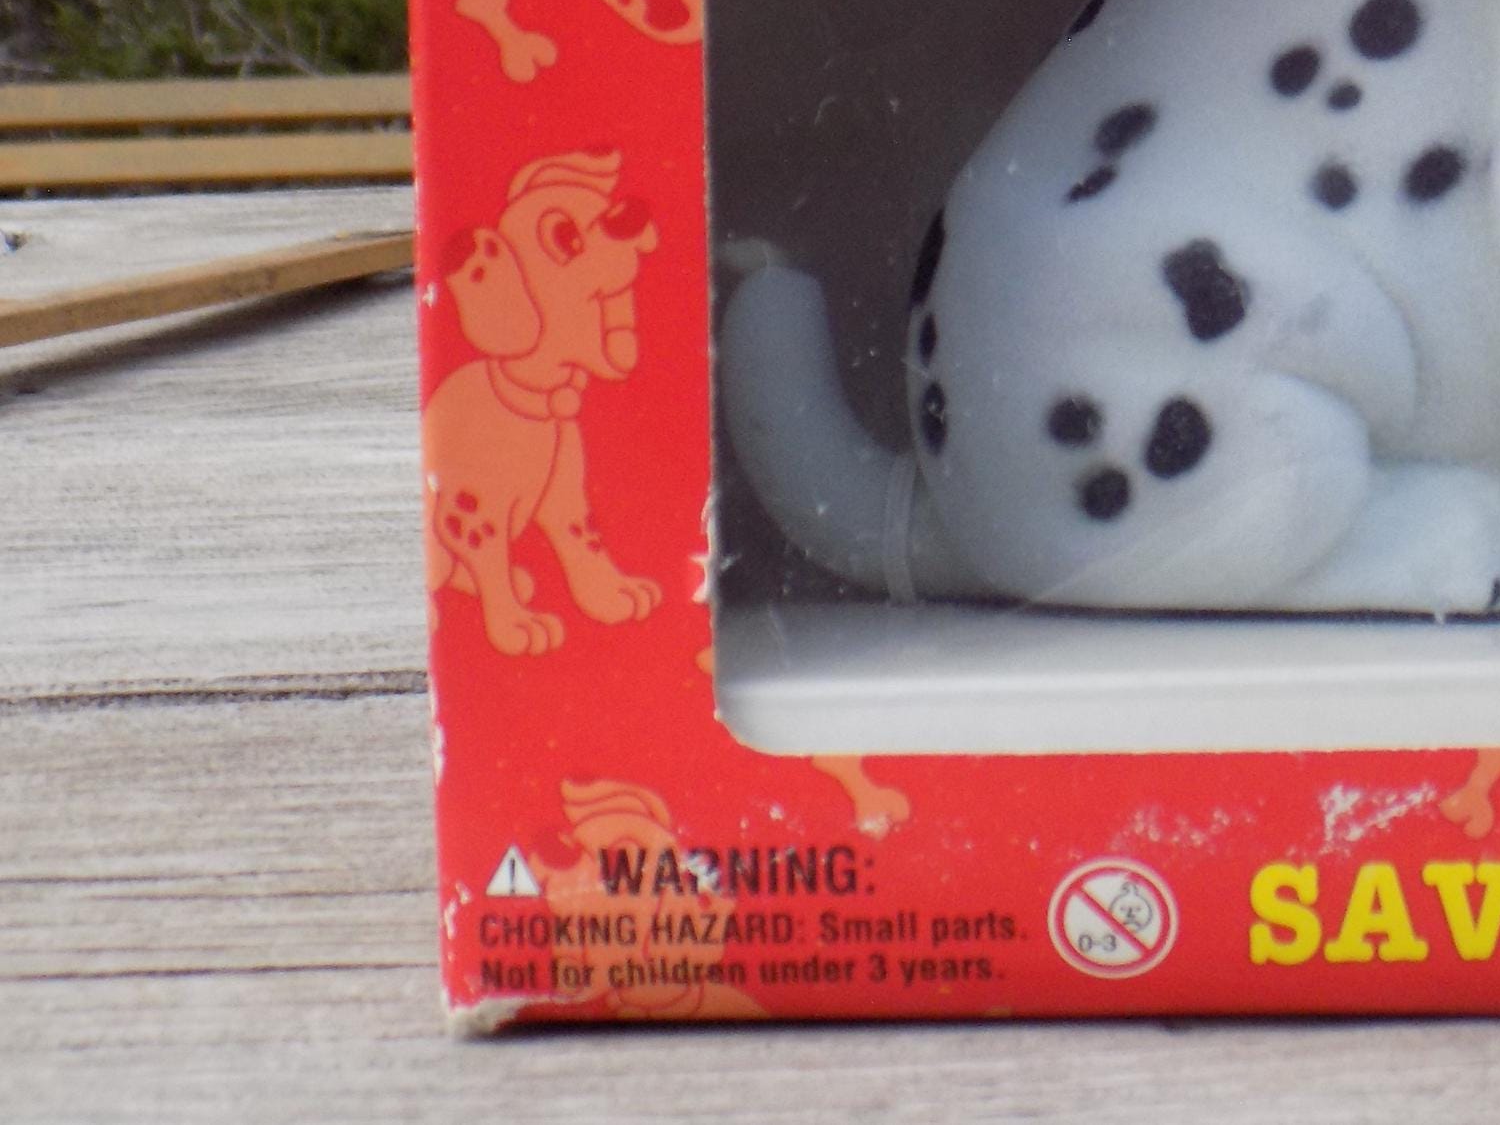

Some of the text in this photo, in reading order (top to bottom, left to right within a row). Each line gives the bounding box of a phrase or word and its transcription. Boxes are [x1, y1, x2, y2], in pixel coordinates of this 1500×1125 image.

[599, 845, 877, 898] WARNING:
[479, 912, 638, 949] CHOKING
[818, 909, 918, 945] Small
[930, 911, 1029, 948] parts.
[1077, 933, 1118, 953] 0-3
[479, 958, 538, 992] Not
[550, 955, 595, 990] for
[607, 954, 747, 989] children
[758, 953, 856, 986] under
[868, 953, 890, 984] 3
